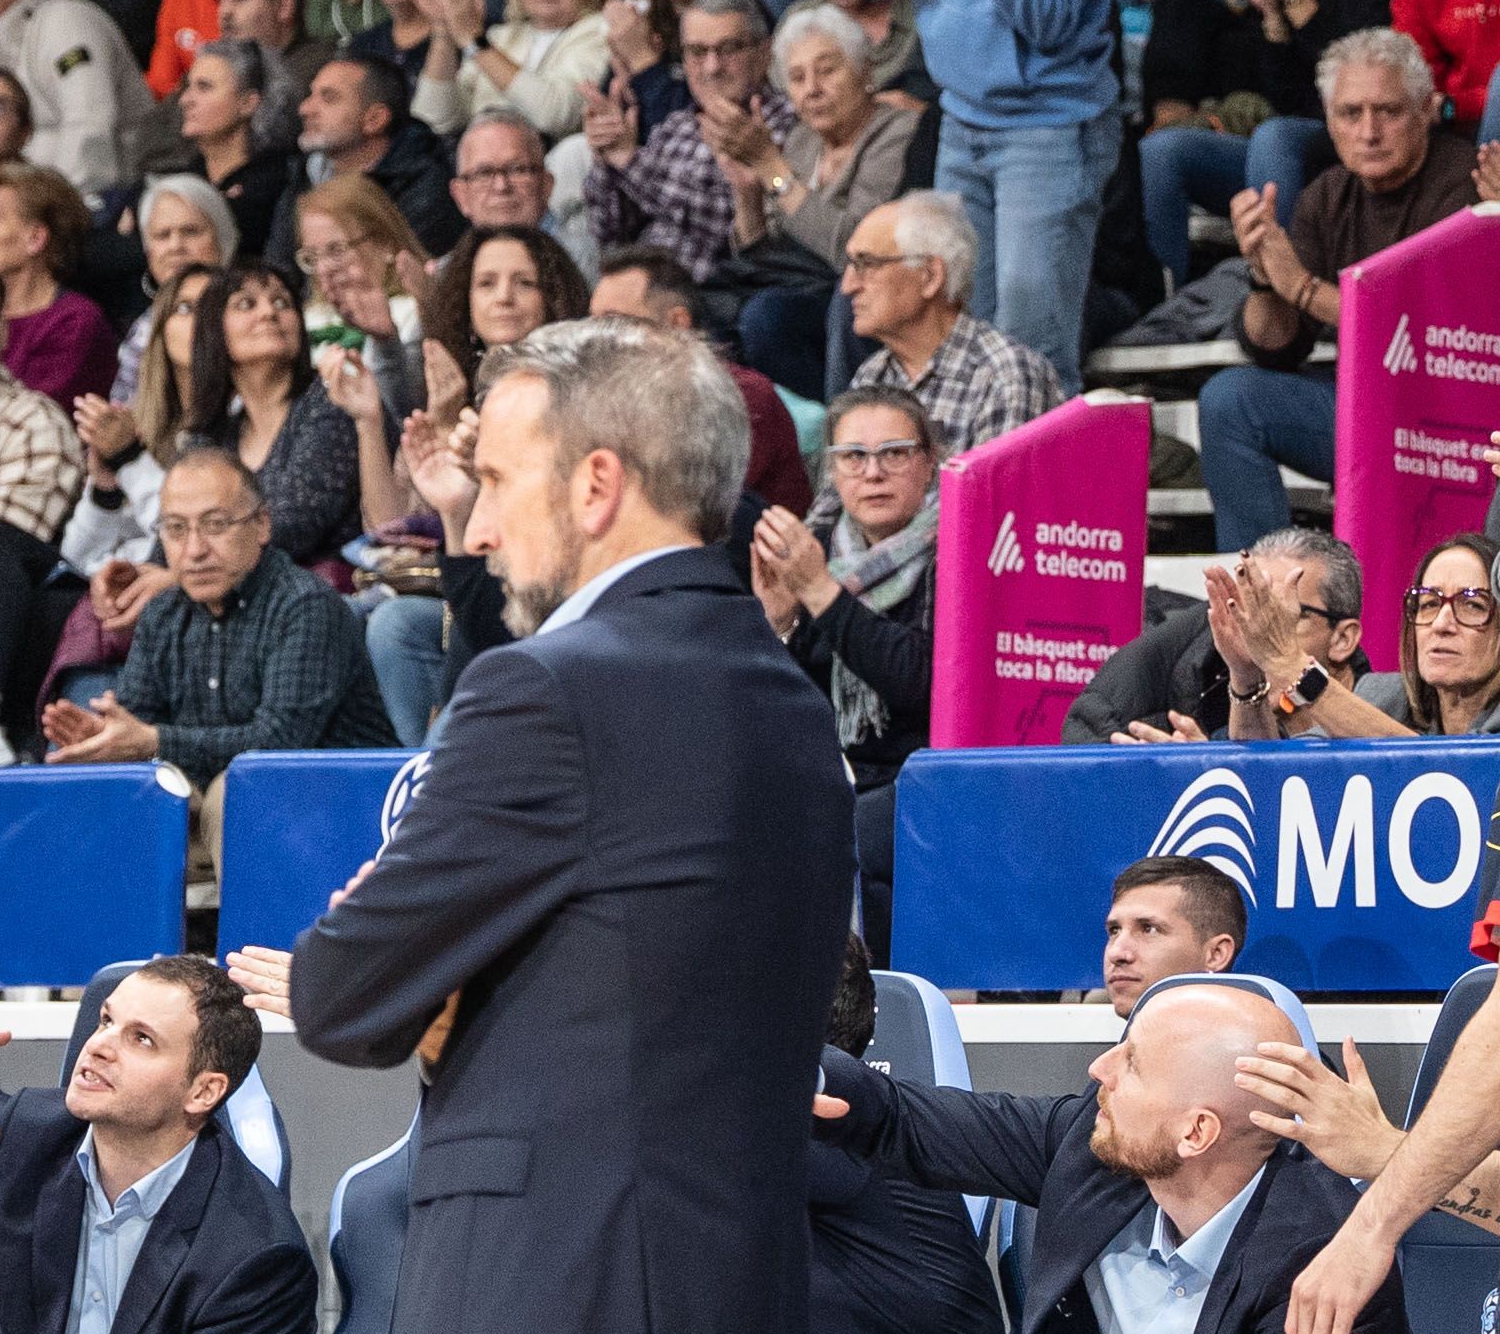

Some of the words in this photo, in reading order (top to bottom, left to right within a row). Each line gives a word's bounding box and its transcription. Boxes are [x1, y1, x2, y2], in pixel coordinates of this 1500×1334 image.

[1394, 453, 1426, 475] toca
[1426, 458, 1440, 478] la
[1440, 458, 1478, 484] fibra
[1035, 522, 1124, 554] andorra
[1035, 549, 1128, 584] telecom
[996, 632, 1012, 653] El
[996, 659, 1034, 679] toca
[1035, 661, 1052, 682] la
